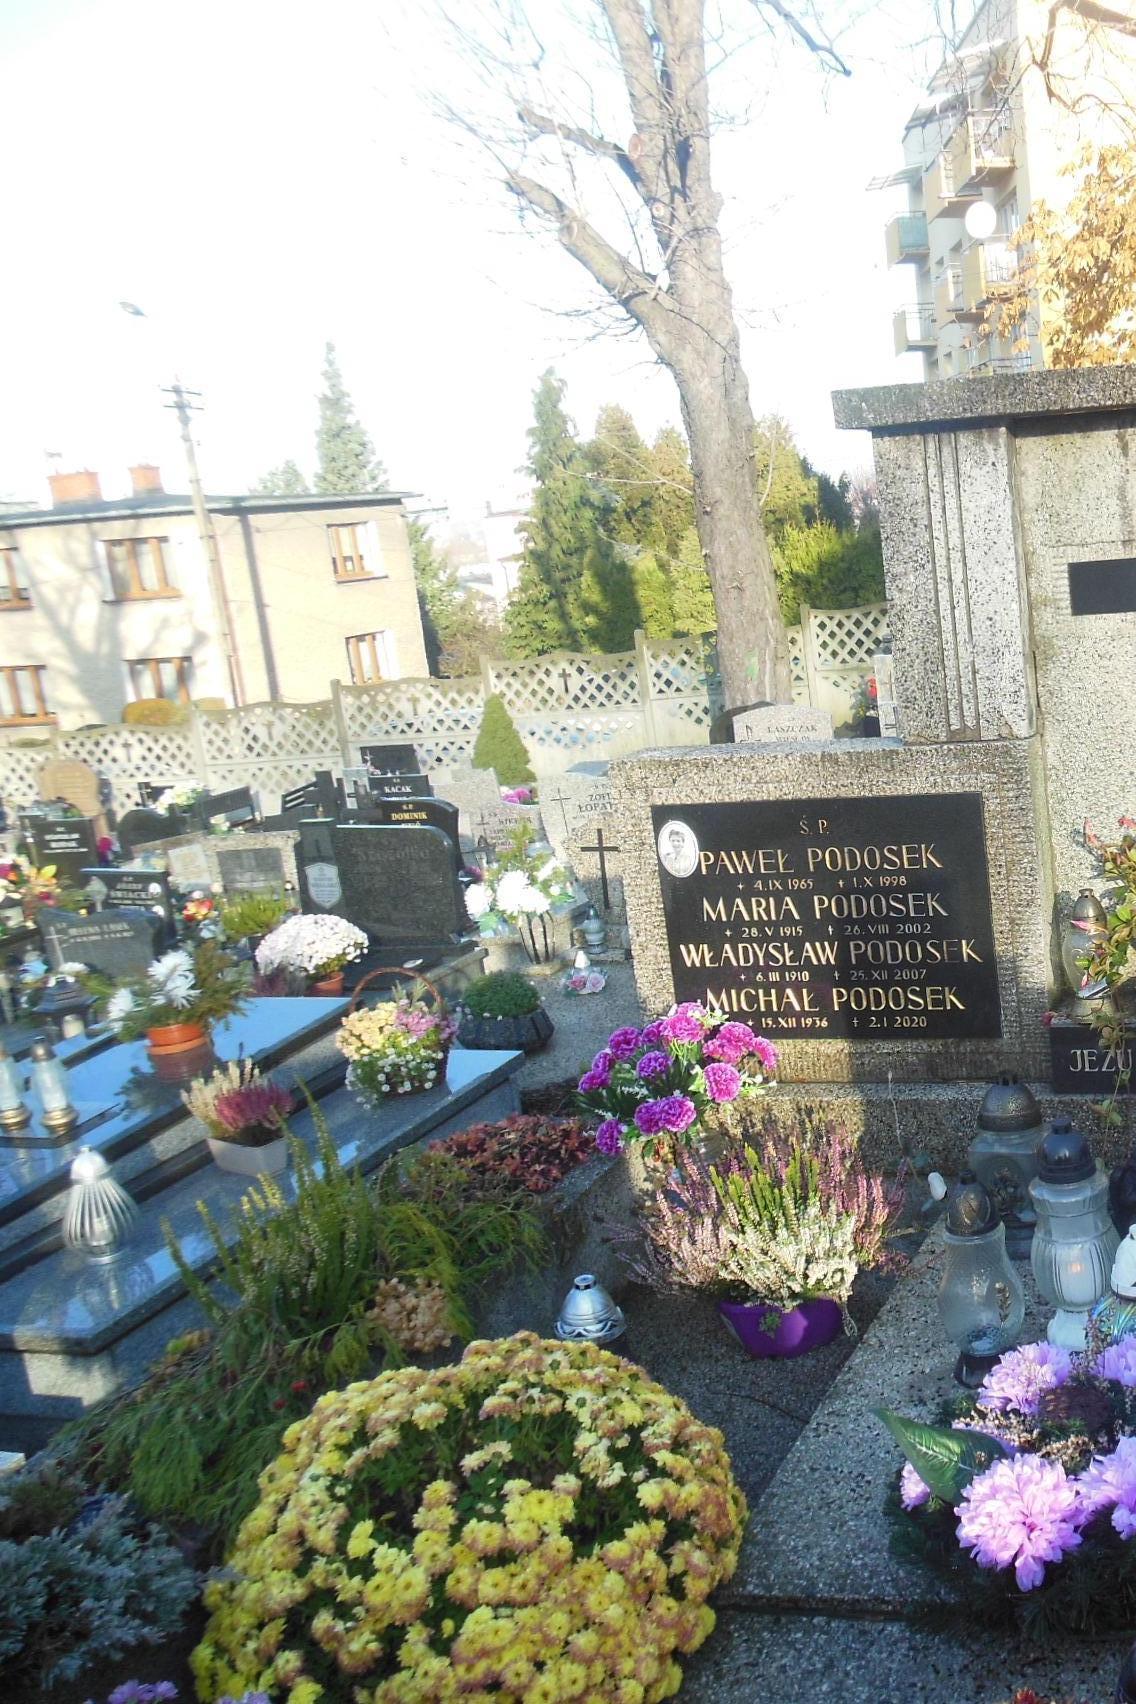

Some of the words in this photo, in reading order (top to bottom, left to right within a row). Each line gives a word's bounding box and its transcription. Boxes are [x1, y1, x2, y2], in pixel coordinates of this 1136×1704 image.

[578, 801, 614, 812] ŁOPAT
[391, 811, 428, 821] DOMINIK
[700, 849, 795, 876] PAWEŁ
[807, 843, 944, 873] PODOSEK
[788, 878, 814, 891] 1965
[879, 875, 907, 888] 1998
[702, 895, 801, 923] MARIA
[813, 892, 949, 921] PODOSEK
[779, 925, 803, 937] 1915
[896, 922, 932, 935] 2002
[679, 940, 839, 969] WŁADYSŁAW
[849, 938, 985, 966] PODOSEK
[785, 971, 810, 983] 1910
[894, 969, 928, 981] 2007
[706, 987, 821, 1013] MICHAŁ
[832, 985, 967, 1012] PODOSEK
[894, 1016, 928, 1028] 2020
[1070, 1048, 1133, 1072] JEZU
